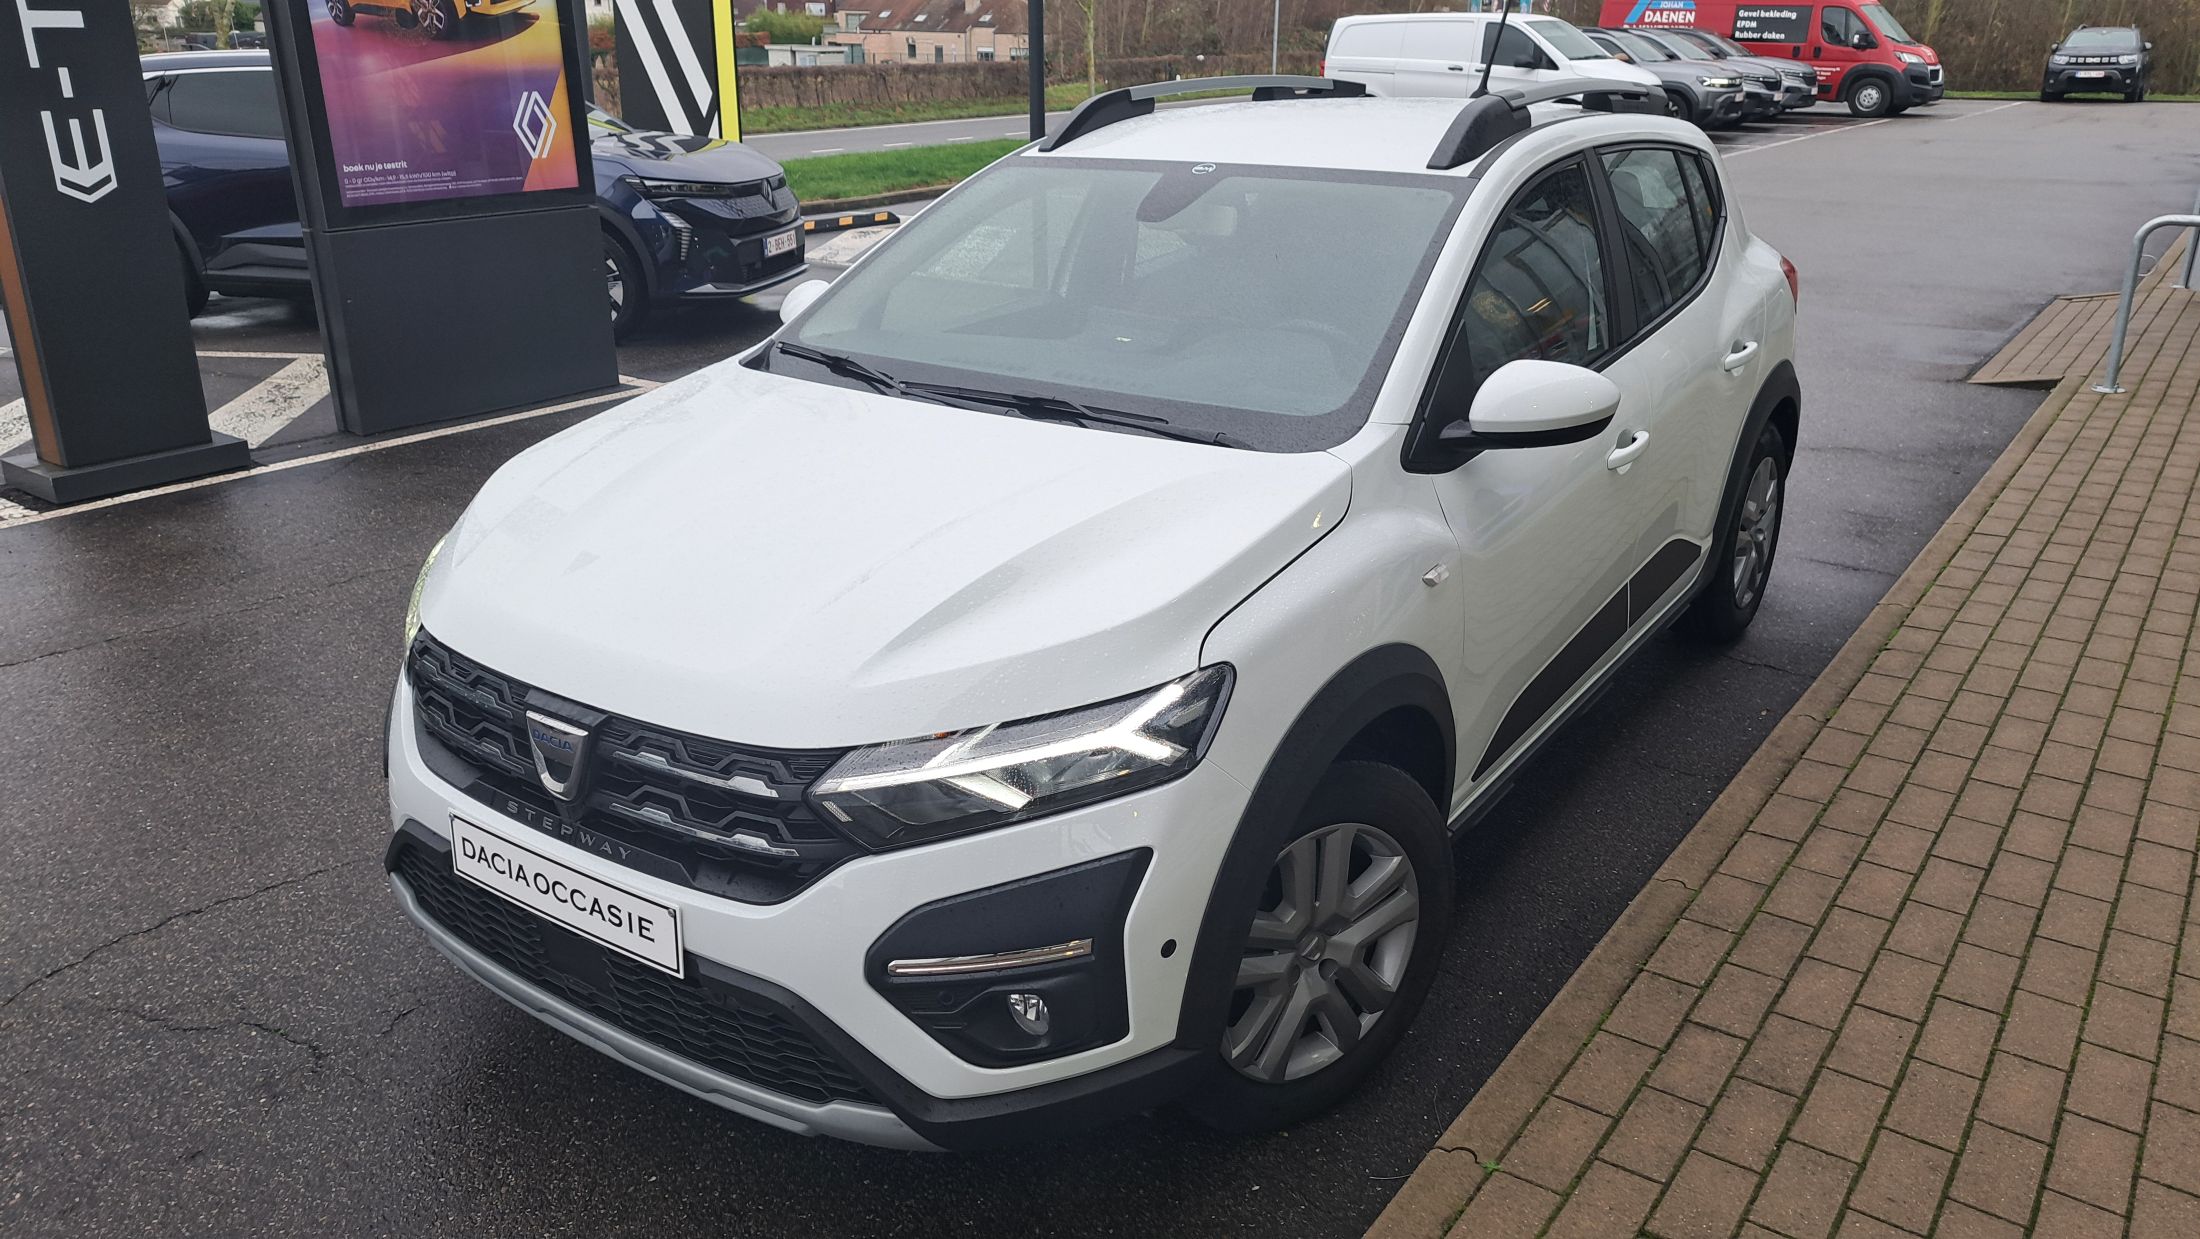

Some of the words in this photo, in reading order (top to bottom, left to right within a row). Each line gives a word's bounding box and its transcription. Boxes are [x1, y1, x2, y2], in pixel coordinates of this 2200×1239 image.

[1644, 10, 1696, 23] DAENEN
[1738, 9, 1760, 18] Gevel
[1760, 9, 1797, 20] bekleding
[1736, 20, 1757, 28] EPDM
[1734, 31, 1761, 39] Rubber
[1762, 31, 1785, 40] daken
[343, 163, 364, 173] boek
[364, 163, 375, 171] nu
[375, 161, 383, 172] je
[383, 160, 408, 170] testrit
[532, 729, 573, 752] DACIA
[506, 800, 632, 860] STEPWAY
